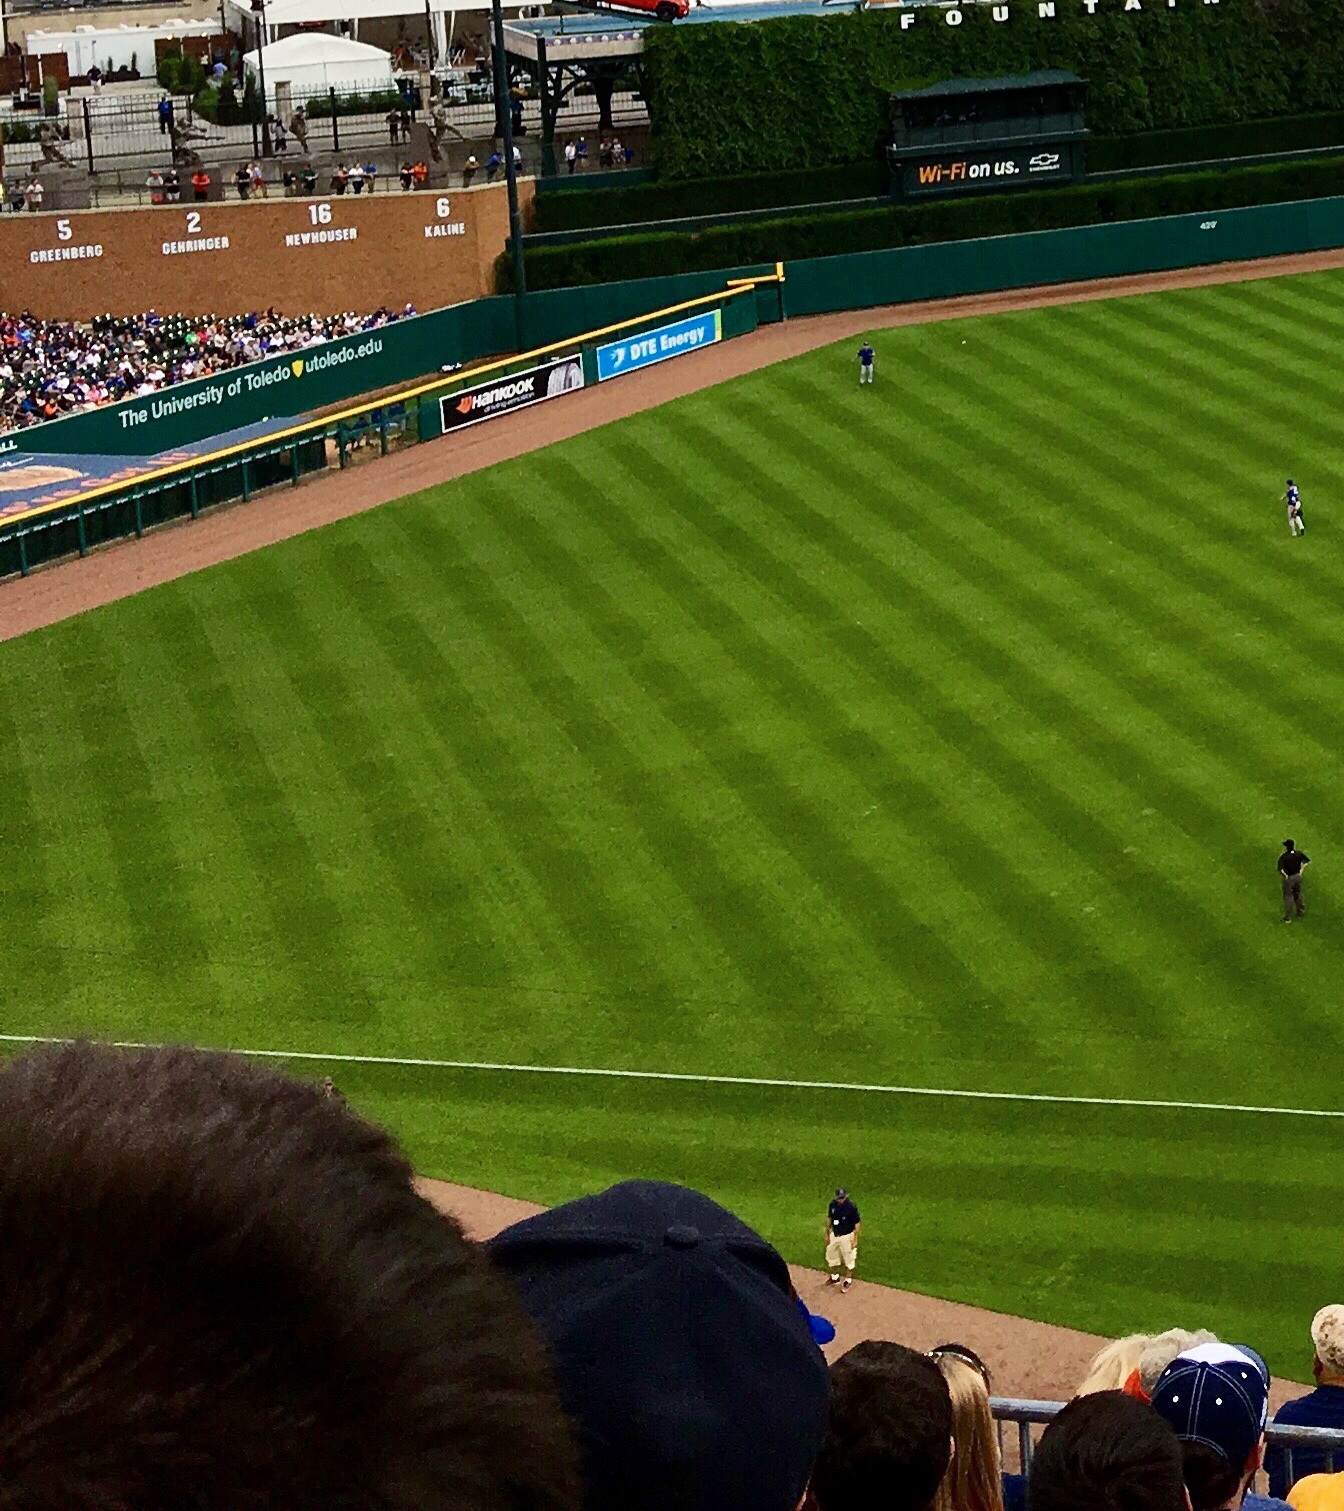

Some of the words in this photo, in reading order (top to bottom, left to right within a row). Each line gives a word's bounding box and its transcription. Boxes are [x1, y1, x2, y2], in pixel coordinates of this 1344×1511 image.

[919, 162, 967, 184] Wi-Fi
[968, 162, 990, 179] on
[994, 161, 1020, 176] us.
[308, 203, 333, 225] 16
[435, 197, 451, 218] 6
[56, 219, 73, 240] 5
[186, 212, 202, 233] 2
[424, 222, 466, 238] KALINE
[162, 236, 230, 255] GEHRINGER
[285, 227, 358, 247] NEWHOUSER
[30, 244, 103, 263] GREENBERG
[630, 338, 658, 361] DTE
[659, 325, 706, 351] Energy
[305, 339, 383, 373] utoledo.edu
[118, 409, 148, 428] The
[150, 387, 224, 419] University
[227, 379, 243, 397] of
[244, 365, 291, 391] Toledo
